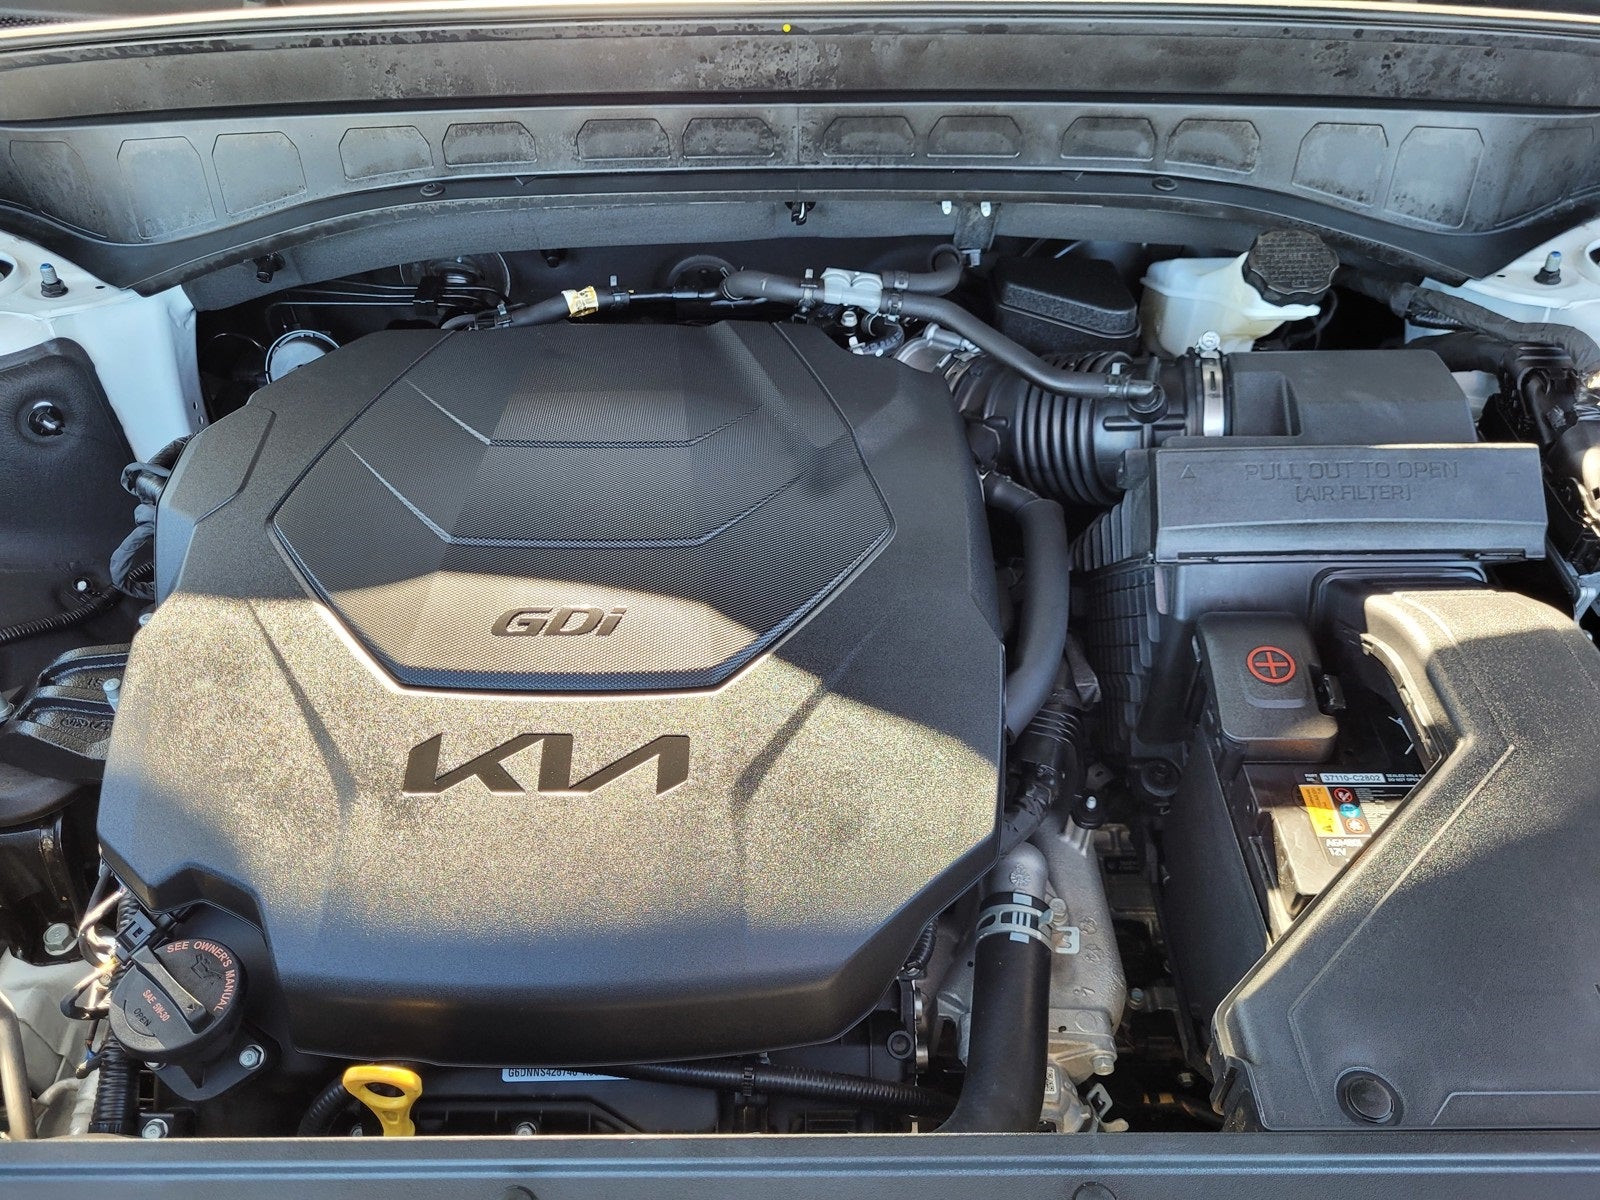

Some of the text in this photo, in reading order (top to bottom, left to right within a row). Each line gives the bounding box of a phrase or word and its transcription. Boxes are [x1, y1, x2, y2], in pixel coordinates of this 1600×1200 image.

[1244, 460, 1459, 481] PULL OUT TO OPEN
[490, 606, 627, 637] GDi
[402, 732, 690, 797] KIA
[1323, 774, 1381, 782] 37110-C2802
[167, 940, 236, 1012] SEE OWNER'S MANUAL
[142, 989, 157, 1005] SAE
[133, 1007, 152, 1027] OPEN
